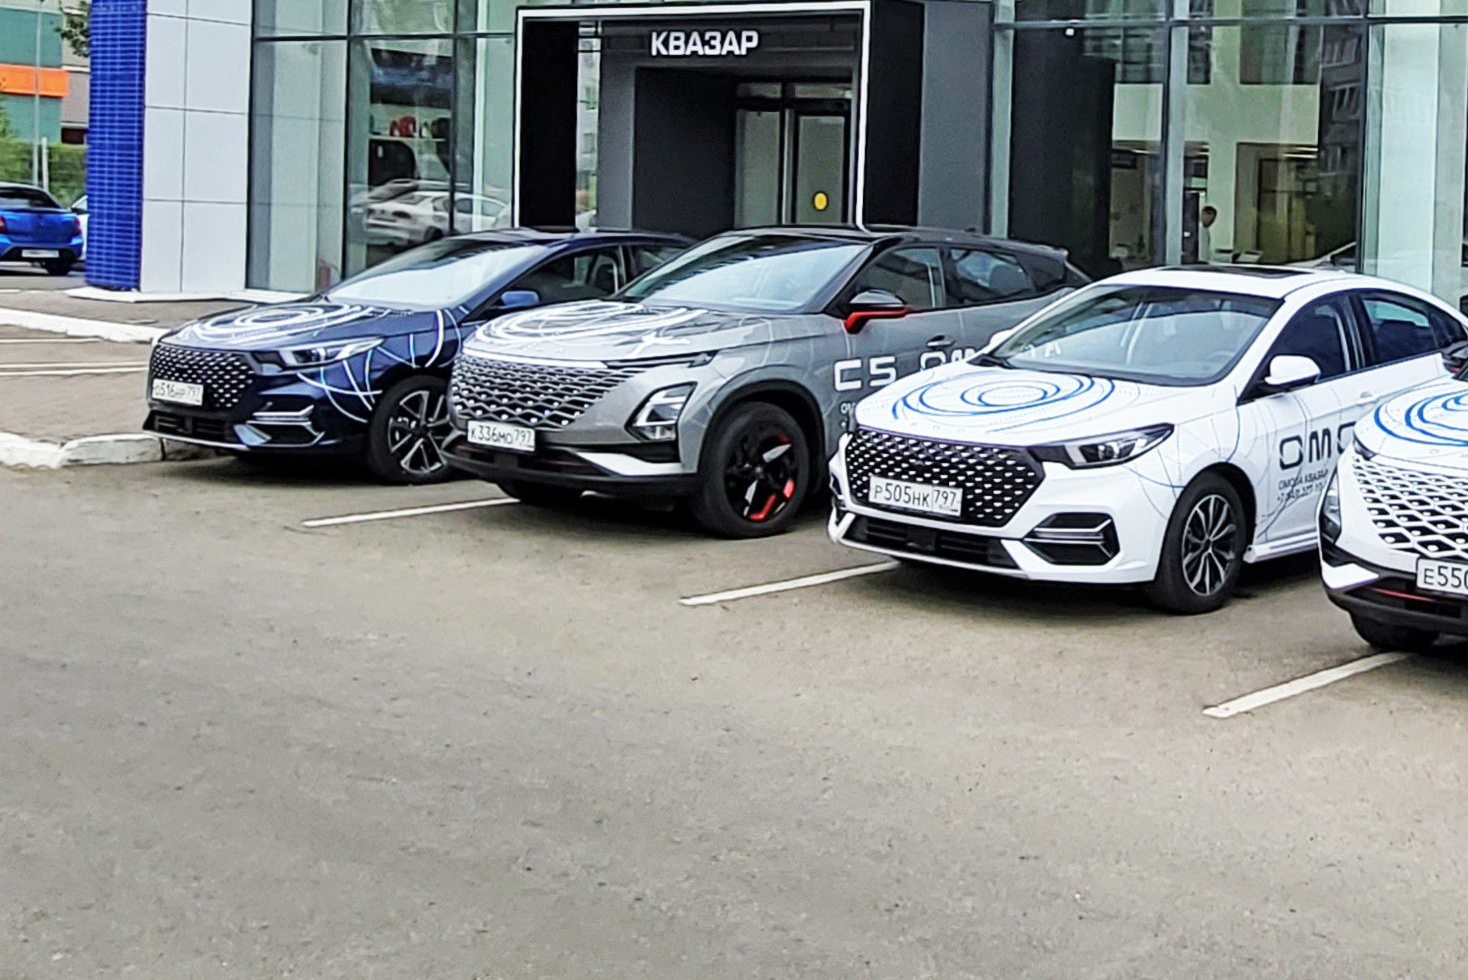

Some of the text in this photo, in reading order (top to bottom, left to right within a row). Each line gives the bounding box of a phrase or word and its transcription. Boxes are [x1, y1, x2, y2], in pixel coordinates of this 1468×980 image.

[651, 30, 759, 56] КВАЗАР
[834, 355, 897, 392] C5
[934, 489, 956, 507] 797
